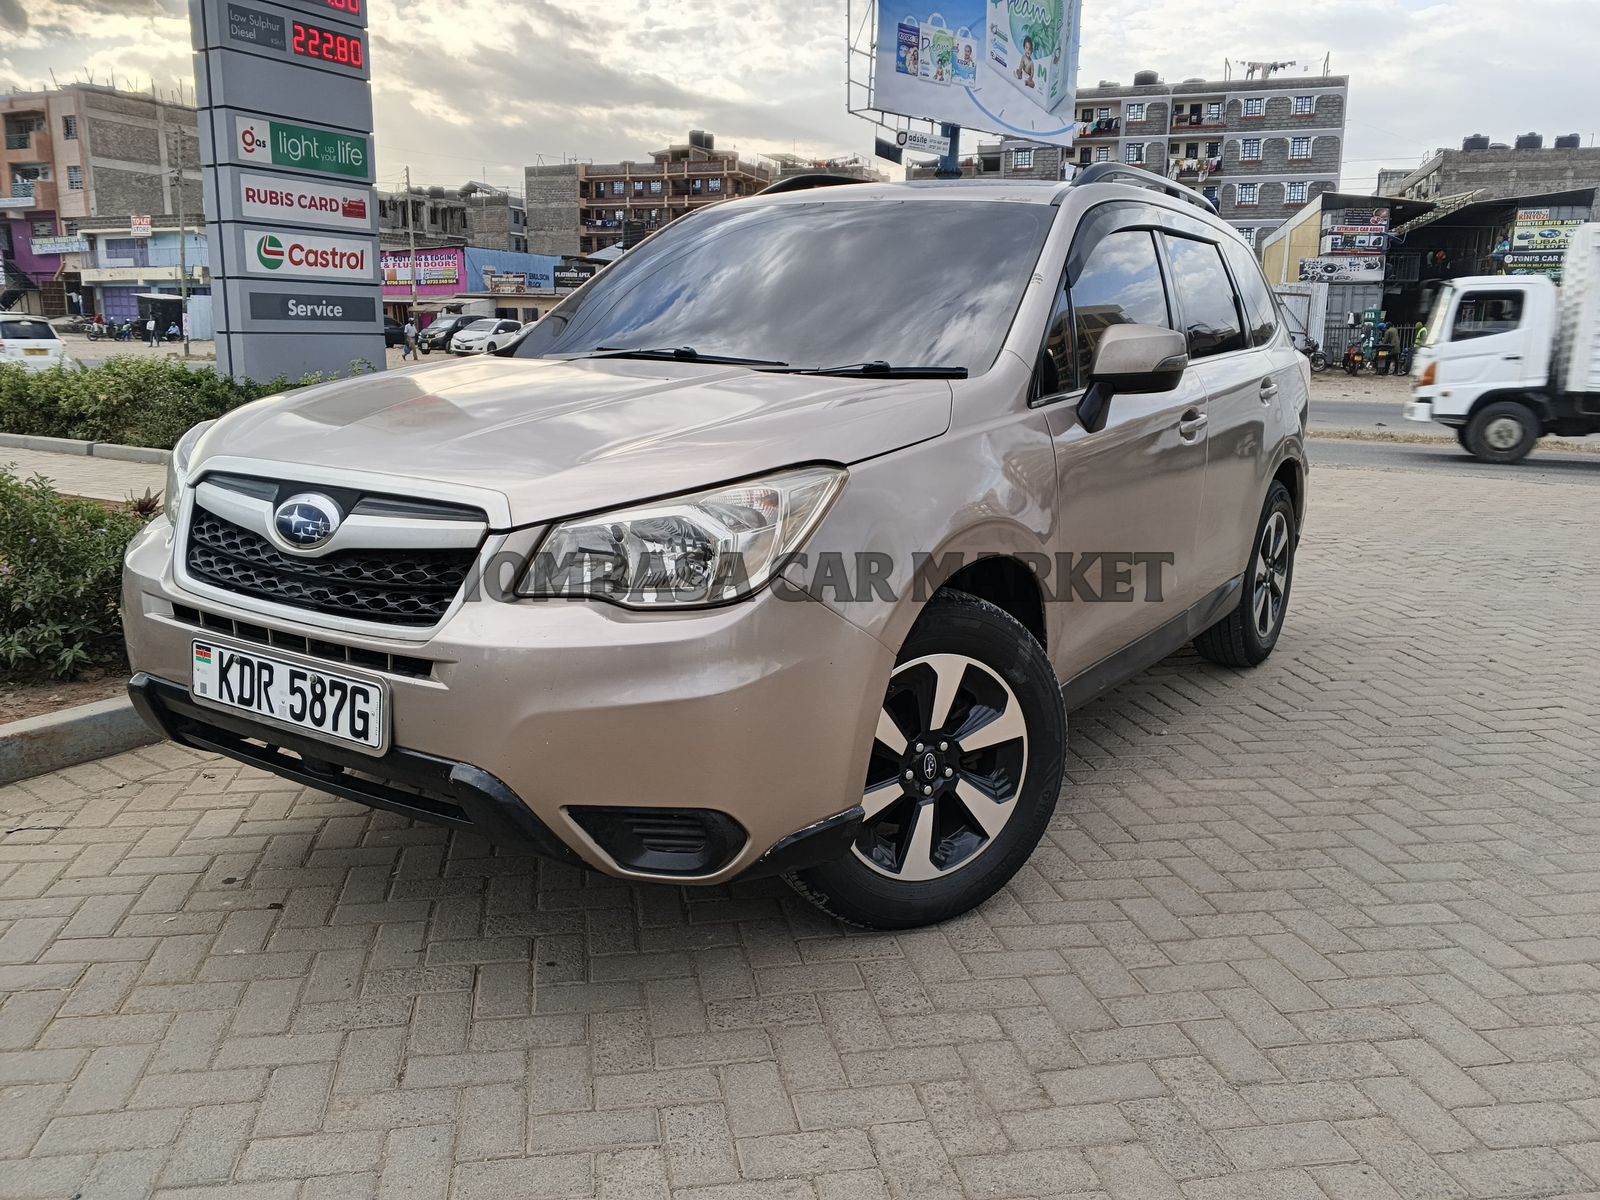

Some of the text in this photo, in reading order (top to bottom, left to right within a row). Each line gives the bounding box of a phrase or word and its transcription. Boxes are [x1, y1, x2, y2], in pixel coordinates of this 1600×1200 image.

[230, 10, 281, 32] Low Sulphur
[991, 0, 1051, 25] ream
[231, 24, 257, 39] Diesel
[293, 24, 362, 66] 222.80
[278, 130, 364, 167] light up your life
[297, 194, 340, 213] CARD
[288, 243, 364, 270] Castrol
[423, 260, 457, 268] DOORS
[430, 253, 457, 261] EDGING
[287, 299, 343, 317] Service
[218, 650, 275, 714] KDR
[288, 668, 370, 741] 587G
